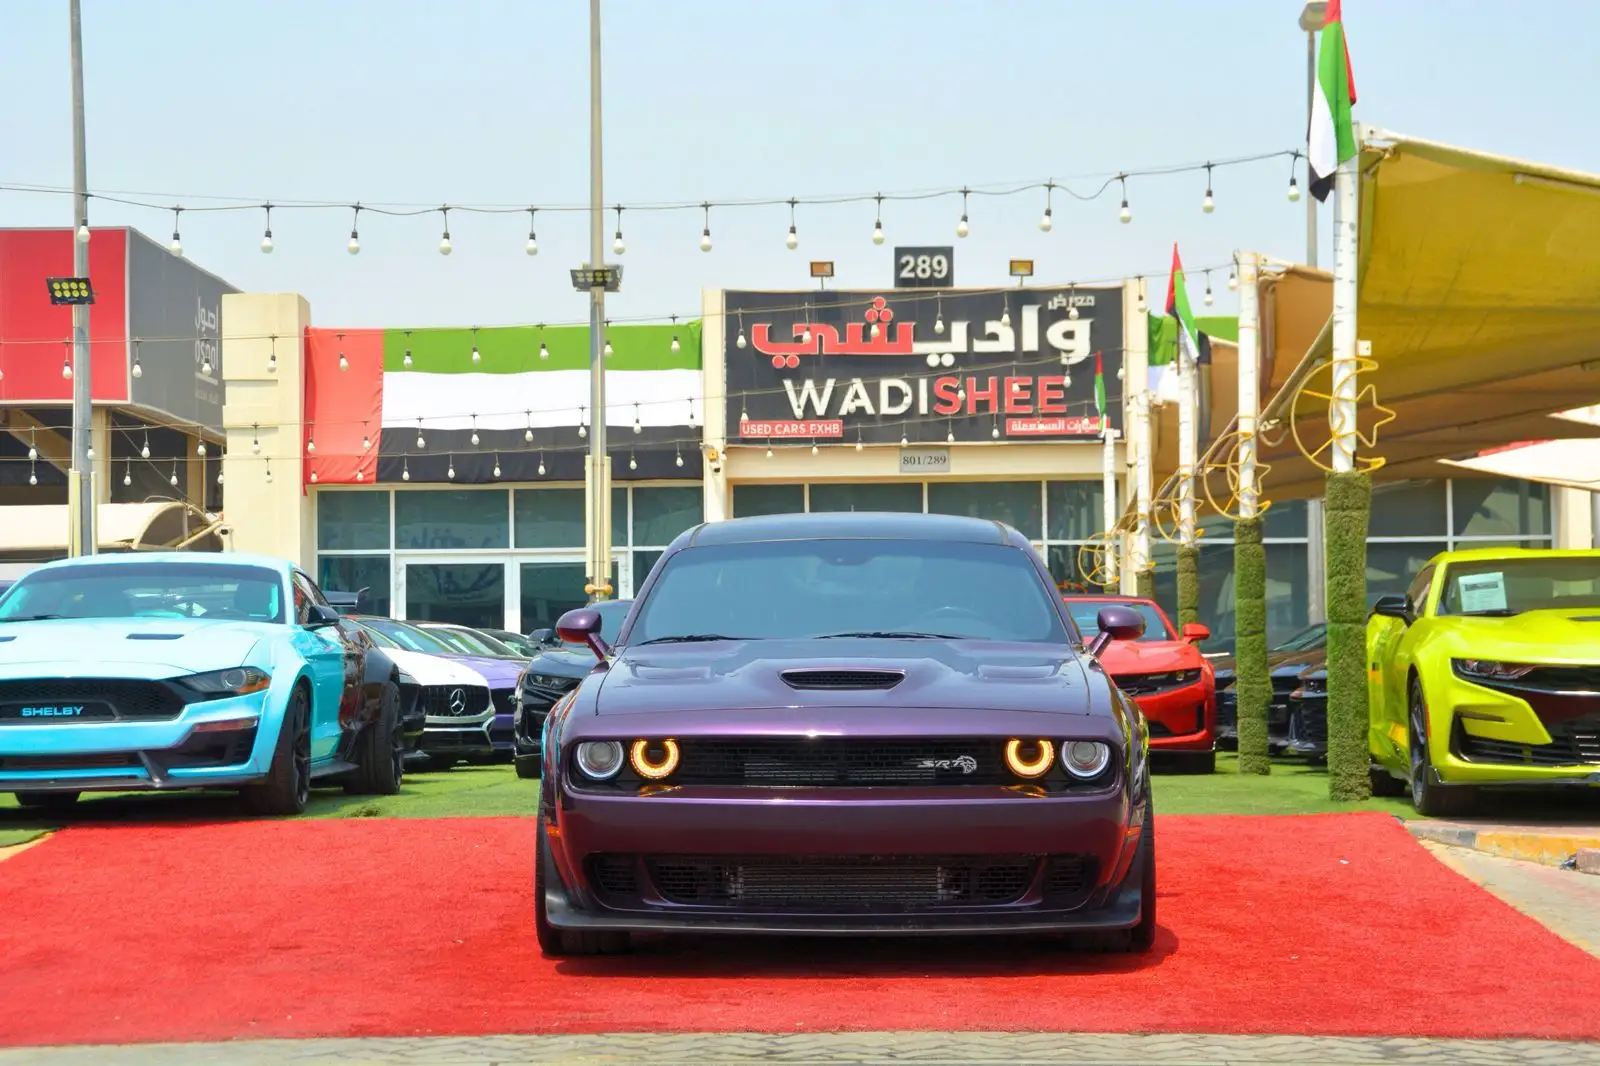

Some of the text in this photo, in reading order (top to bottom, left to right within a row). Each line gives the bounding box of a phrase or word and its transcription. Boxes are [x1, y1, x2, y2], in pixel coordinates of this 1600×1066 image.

[900, 254, 948, 279] 289
[783, 376, 1067, 416] WADISHEE
[742, 423, 771, 435] USED
[775, 423, 806, 434] CARS
[902, 455, 947, 465] 801/289
[22, 706, 84, 716] SHELBY
